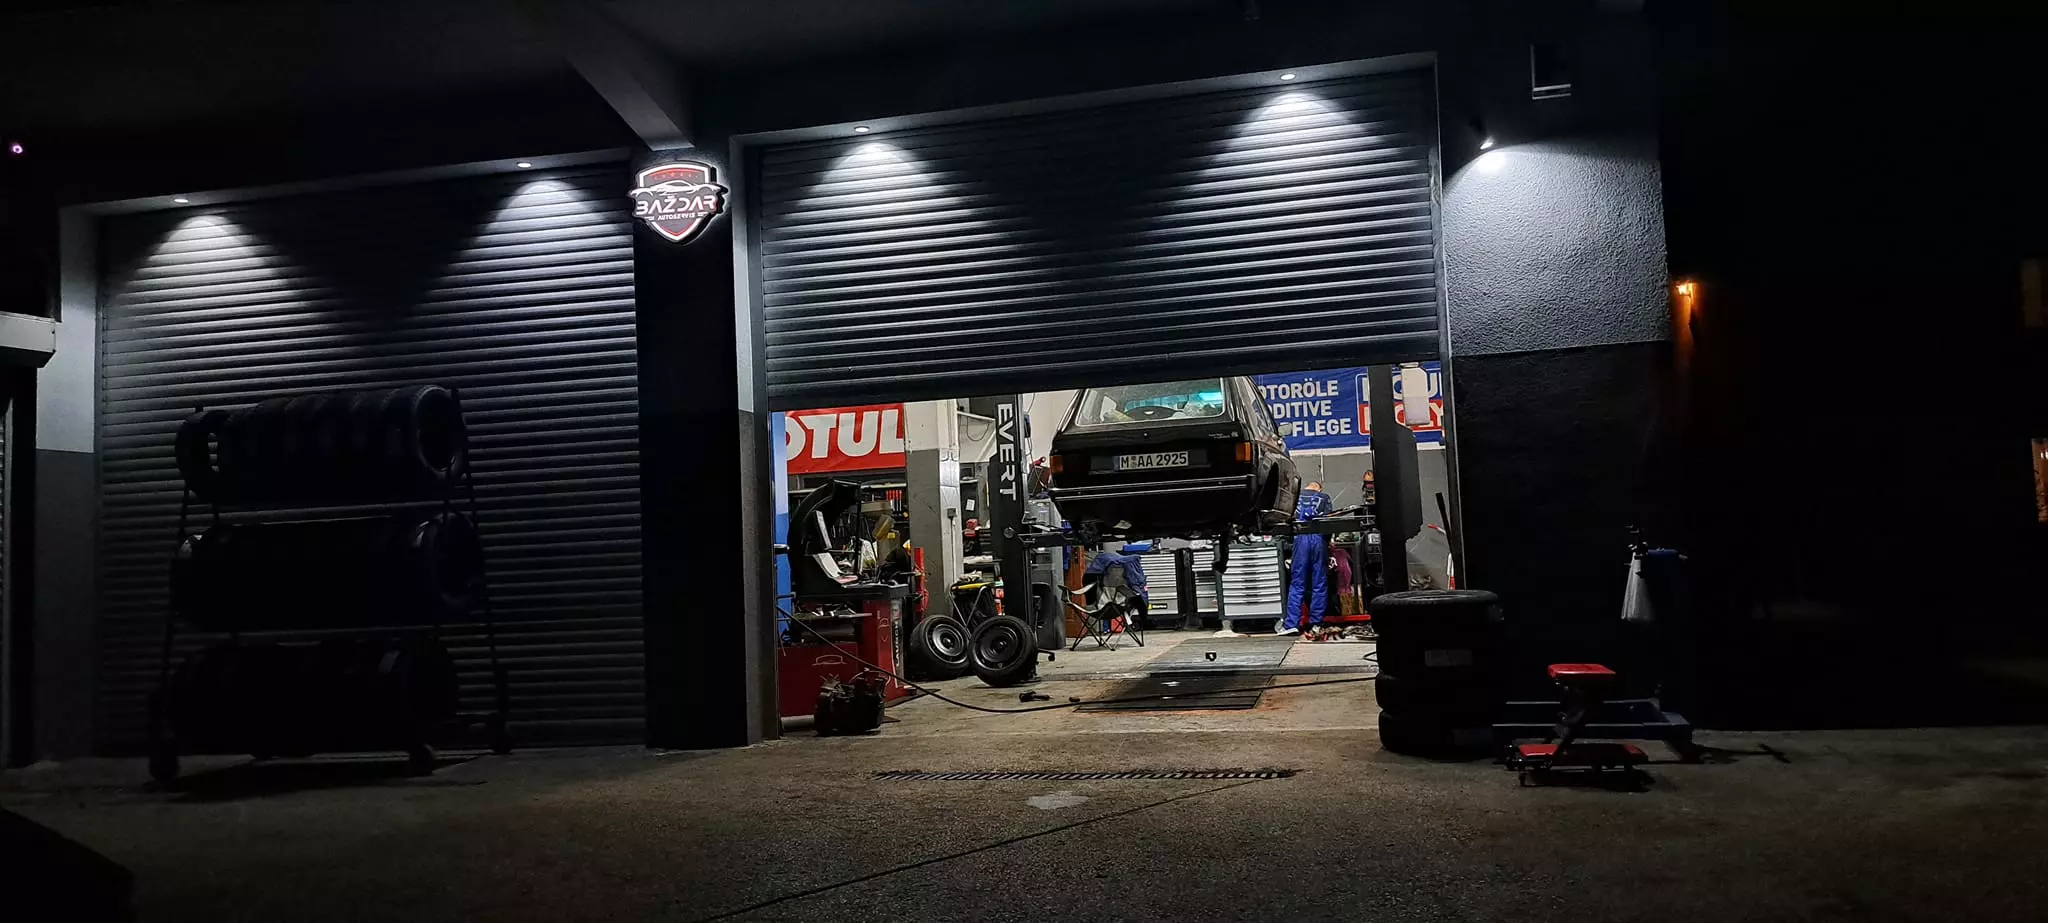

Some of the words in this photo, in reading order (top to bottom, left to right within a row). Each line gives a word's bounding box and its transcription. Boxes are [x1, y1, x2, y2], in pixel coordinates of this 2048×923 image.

[636, 195, 716, 215] BAŽDAR
[1268, 400, 1332, 419] DITIVE
[1280, 418, 1352, 437] FLEGE
[997, 403, 1016, 501] EVERT
[1121, 456, 1130, 469] M
[1138, 455, 1153, 468] AA
[1156, 453, 1186, 466] 2925
